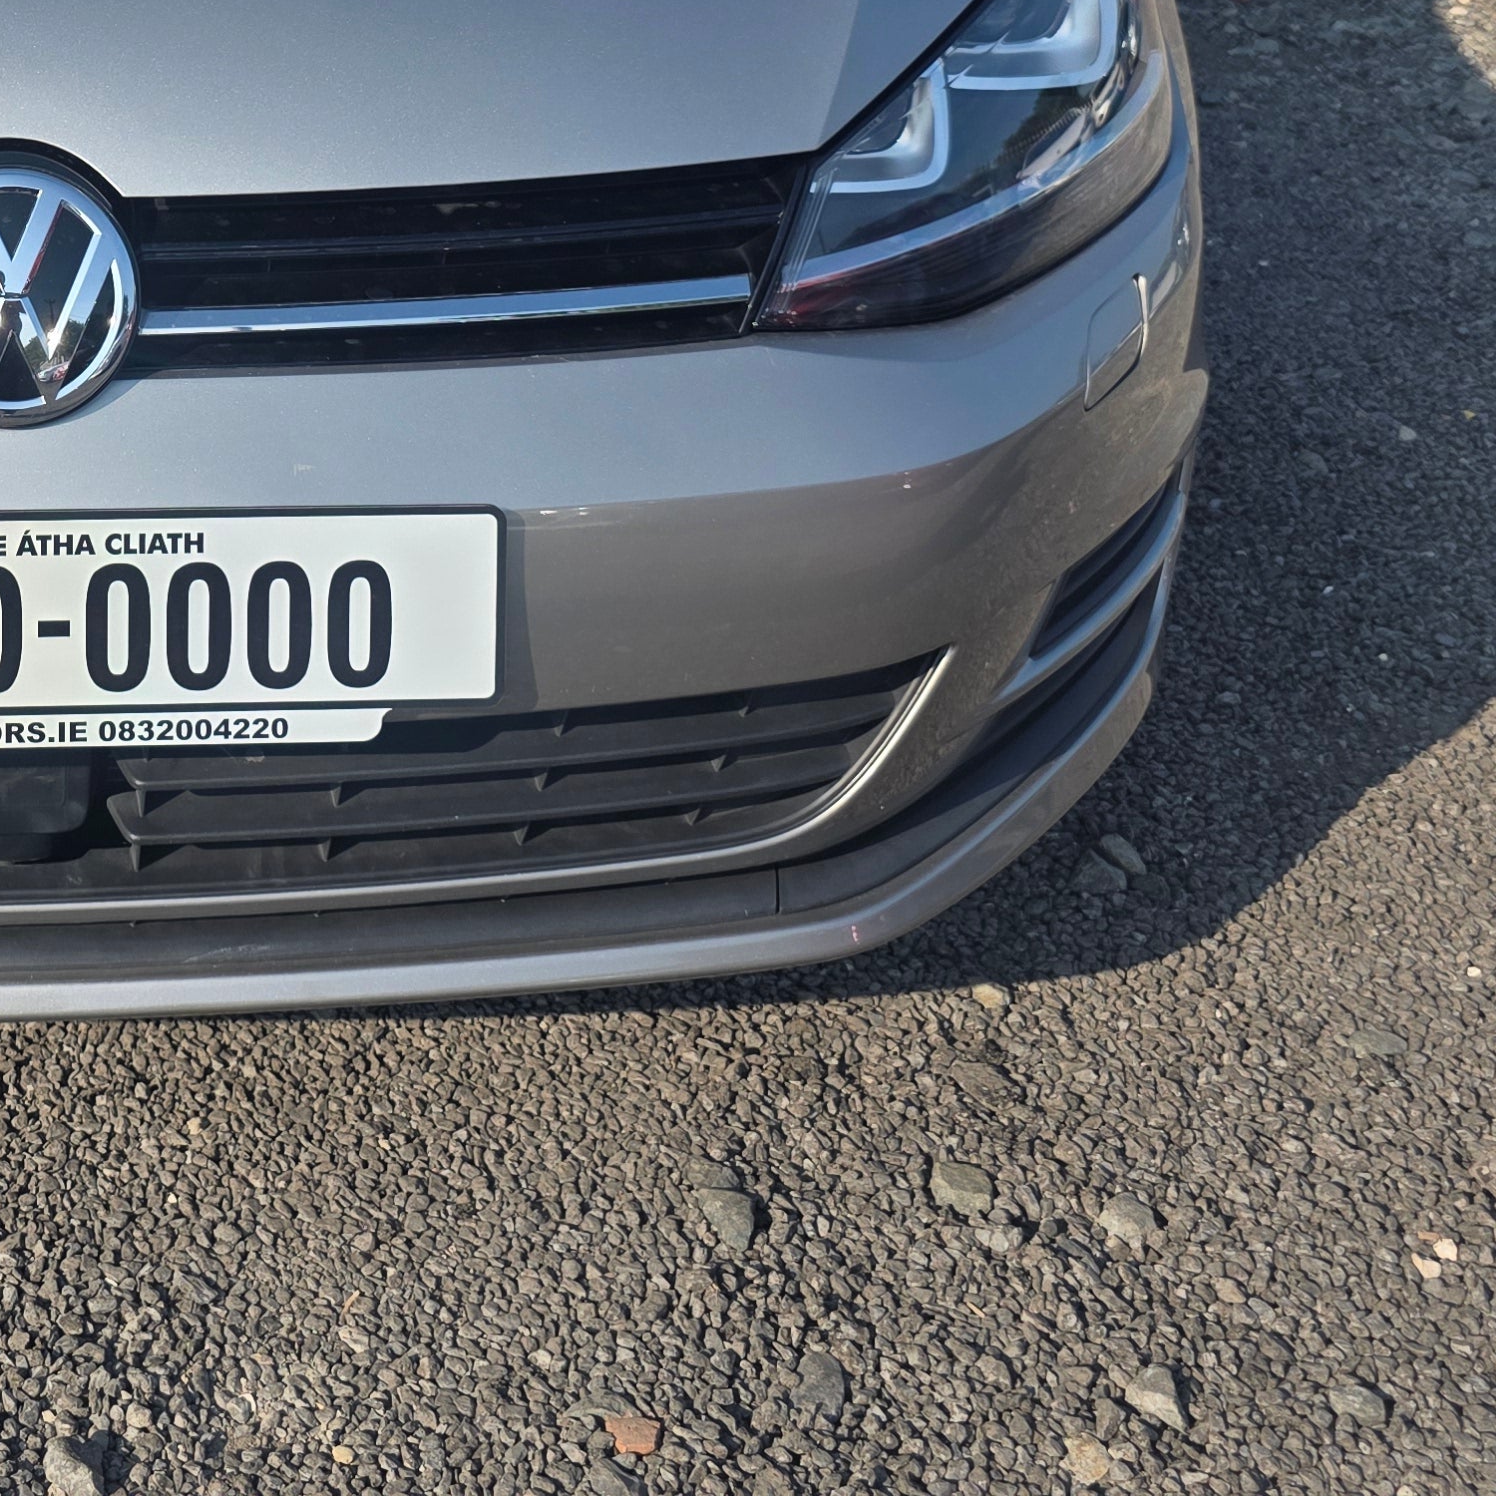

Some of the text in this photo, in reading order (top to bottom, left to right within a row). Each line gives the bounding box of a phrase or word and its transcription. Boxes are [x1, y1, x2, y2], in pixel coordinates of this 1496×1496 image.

[15, 529, 96, 556] ÁTHA
[104, 532, 204, 555] CLIATH
[98, 717, 289, 742] 0832004220
